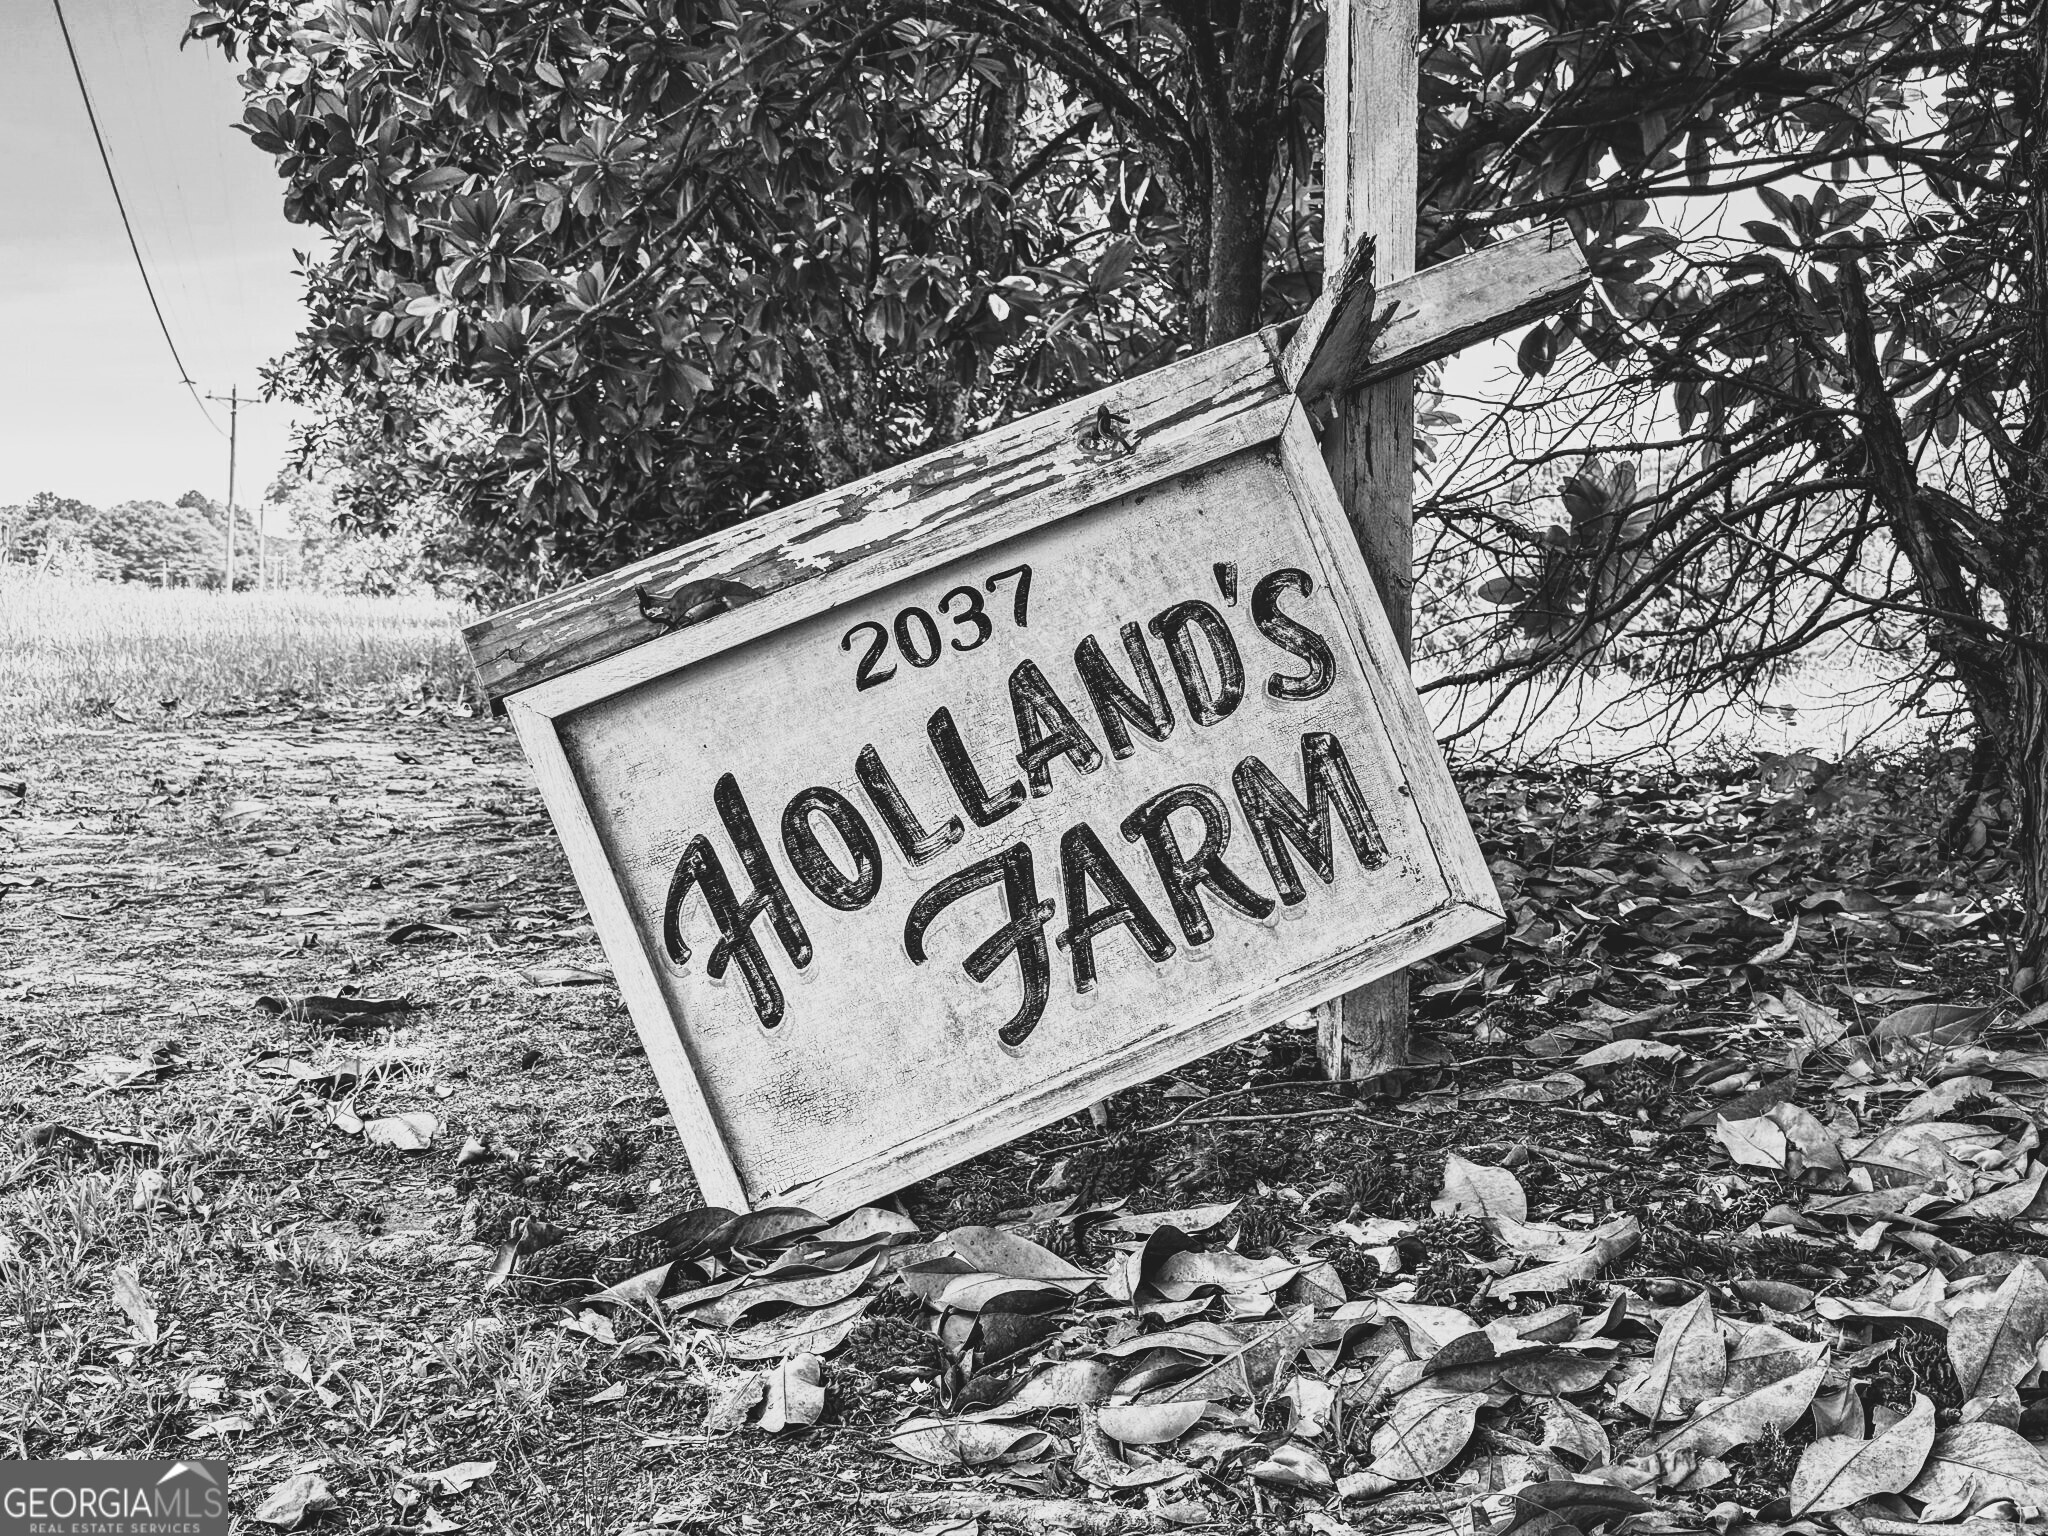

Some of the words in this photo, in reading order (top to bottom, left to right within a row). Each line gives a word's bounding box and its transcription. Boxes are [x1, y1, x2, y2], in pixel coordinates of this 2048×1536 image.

[841, 563, 1032, 692] 2037
[663, 561, 1336, 1030] HOLLAND'S
[903, 731, 1388, 1047] FARM
